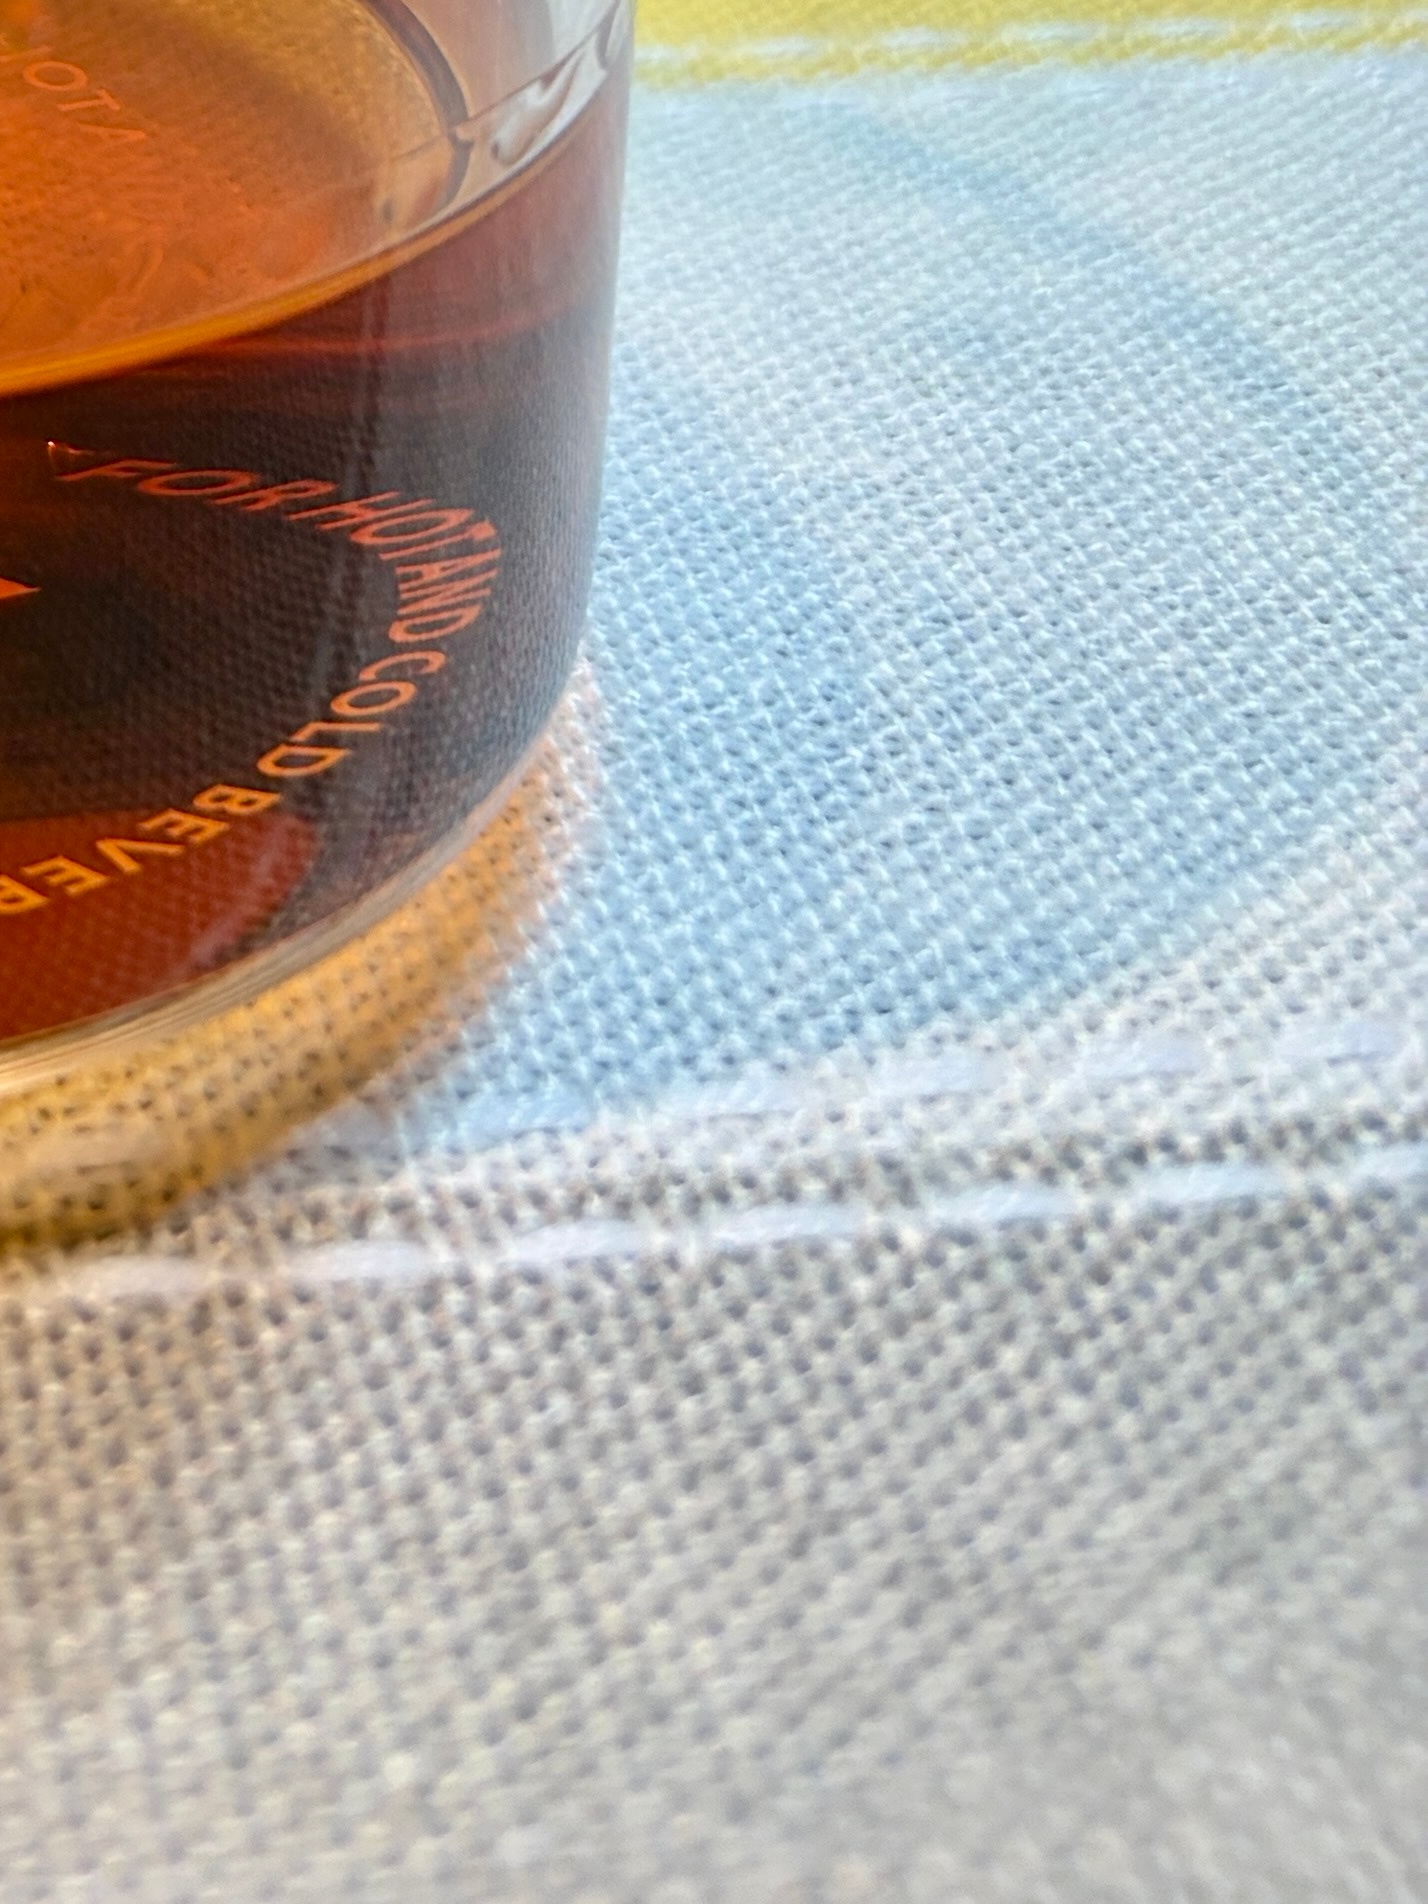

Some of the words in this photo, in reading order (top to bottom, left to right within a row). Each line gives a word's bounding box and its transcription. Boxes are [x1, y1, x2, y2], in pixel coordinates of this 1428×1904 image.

[53, 457, 337, 523] FOR
[283, 489, 500, 564] HOT
[386, 546, 504, 644] AND
[256, 647, 447, 780] COLD
